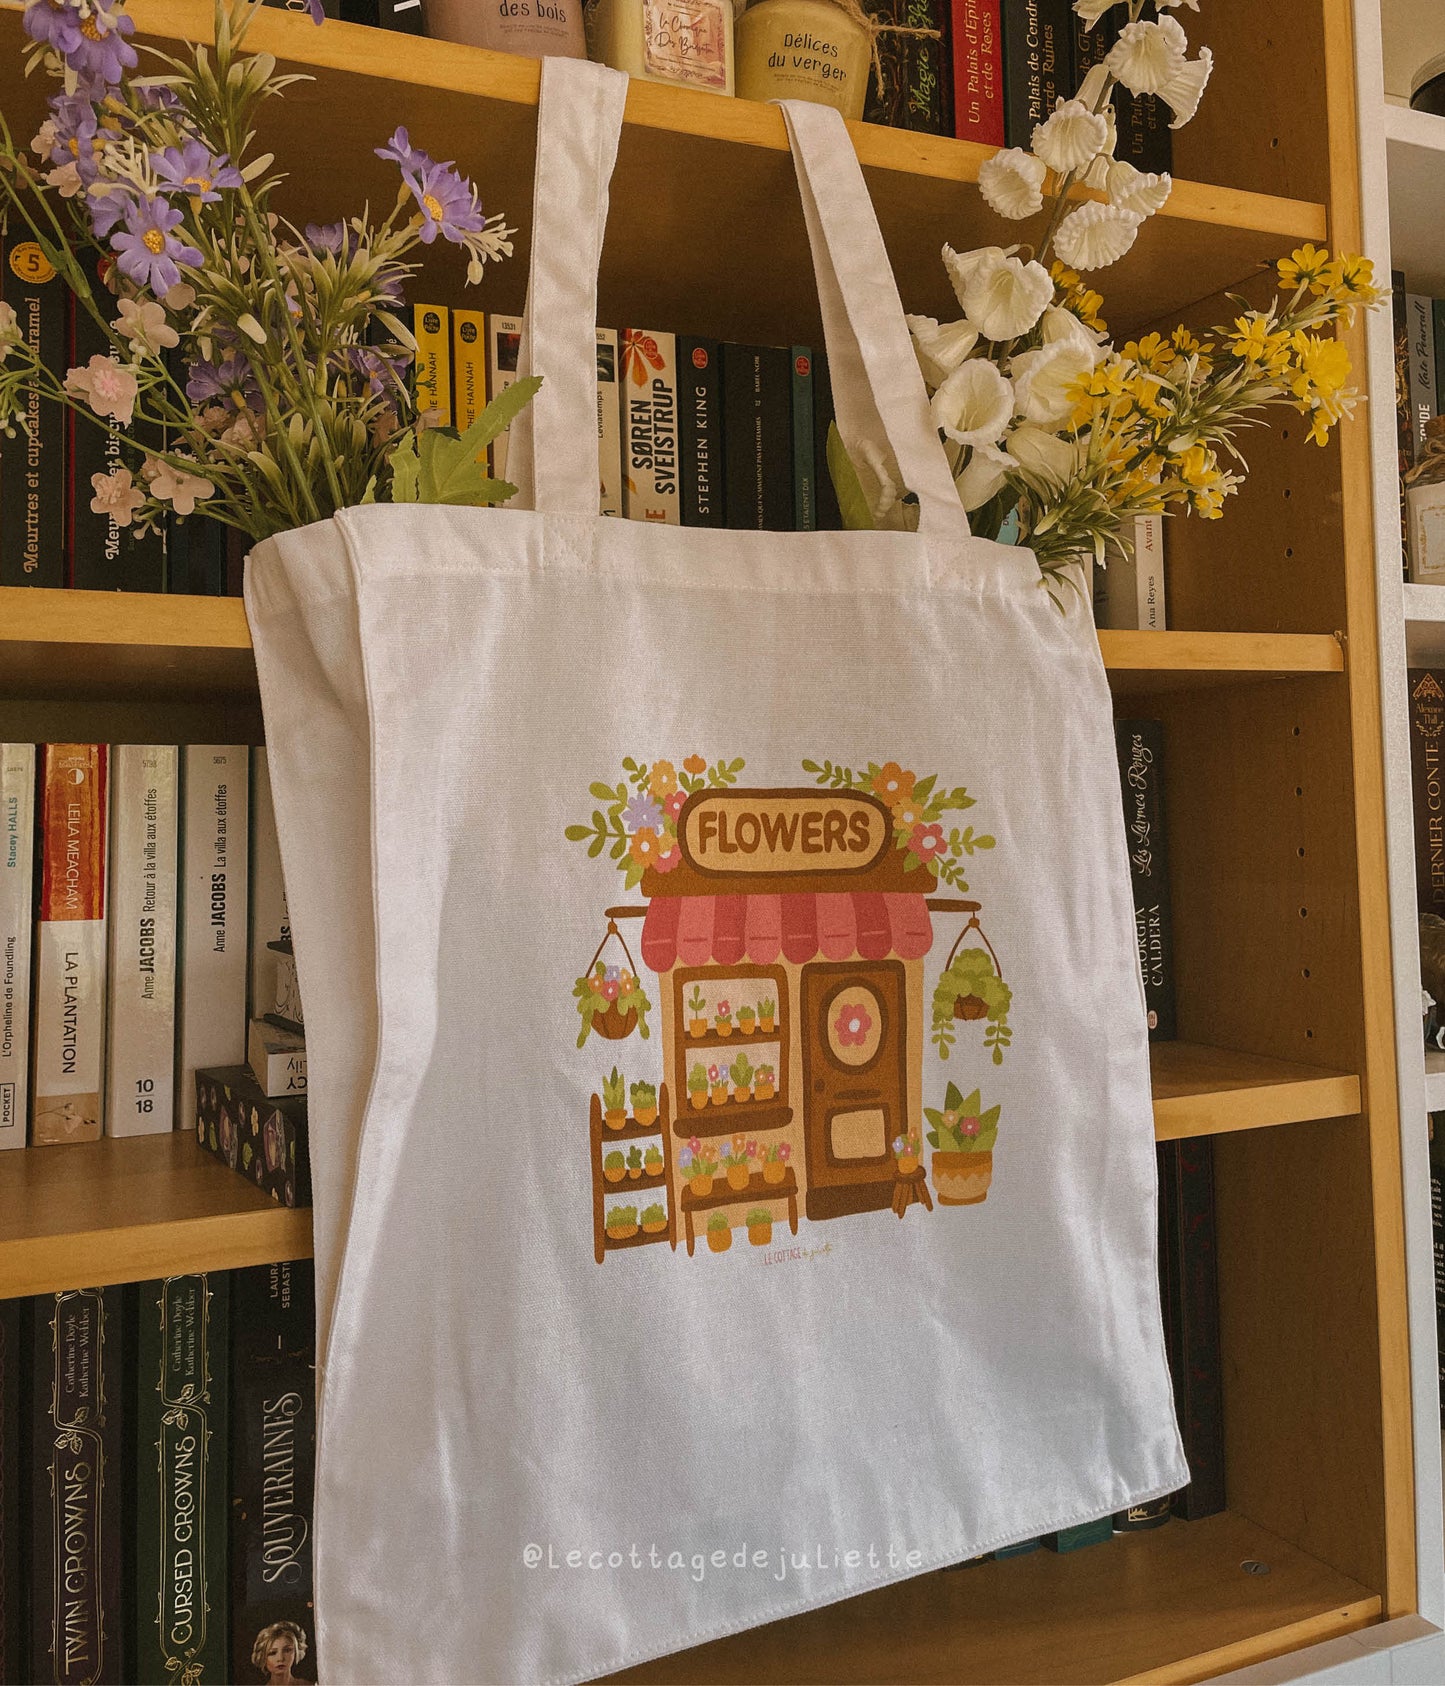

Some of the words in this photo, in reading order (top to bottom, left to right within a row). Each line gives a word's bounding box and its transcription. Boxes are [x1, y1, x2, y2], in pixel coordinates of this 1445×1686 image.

[500, 0, 530, 16] des
[537, 0, 566, 22] bois
[784, 33, 838, 58] Délices
[981, 11, 994, 56] Roses
[1043, 24, 1055, 75] Ruines
[768, 52, 786, 68] du
[793, 56, 847, 81] verger
[966, 48, 979, 95] Palais
[981, 62, 993, 80] de
[1026, 52, 1040, 71] de
[983, 82, 994, 99] et
[1028, 74, 1041, 119] Palais
[968, 100, 980, 123] Un
[28, 254, 40, 272] 5
[25, 297, 41, 360] aramel
[428, 352, 438, 396] HANNAH
[465, 361, 475, 406] HANNAH
[695, 386, 708, 429] KING
[26, 392, 43, 467] cupcakes
[630, 399, 653, 470] SØREN
[652, 378, 676, 495] SVEISTRUP
[25, 472, 39, 488] et
[697, 438, 710, 514] STEPHEN
[23, 492, 39, 573] Meurtres
[1145, 520, 1153, 552] Avant
[1147, 576, 1157, 605] Reyes
[1148, 607, 1156, 628] Ana
[1127, 734, 1153, 790] Rouges
[1425, 741, 1442, 812] CONTE
[8, 797, 18, 833] HALLS
[144, 788, 157, 821] étoffes
[214, 784, 227, 816] étoffes
[67, 803, 81, 838] LEILA
[147, 823, 156, 840] aux
[217, 818, 227, 835] aux
[698, 809, 870, 854] FLOWERS
[1131, 793, 1151, 847] Larmes
[7, 834, 19, 868] Stacey
[144, 842, 156, 860] villa
[214, 836, 226, 855] villa
[214, 856, 226, 867] La
[1132, 849, 1152, 877] Les
[66, 840, 81, 910] MEACHAM
[144, 862, 156, 871] la
[143, 882, 156, 912] Retour
[211, 873, 226, 927] JACOBS
[139, 918, 155, 973] JACOBS
[213, 929, 225, 952] Anne
[1149, 904, 1164, 987] CALDERA
[4, 936, 17, 985] Foundling
[65, 951, 79, 972] LA
[6, 988, 14, 1000] de
[141, 976, 155, 999] Anne
[2, 1003, 14, 1058] L'Orpheline
[62, 976, 79, 1074] PLANTATION
[136, 1079, 154, 1093] 10
[3, 1088, 12, 1123] POCKET
[136, 1099, 153, 1114] 18
[65, 1314, 79, 1342] Doyle
[79, 1307, 90, 1348] Webber
[174, 1435, 196, 1543] CROWNS
[262, 1392, 308, 1585] SOUVERAINES
[65, 1462, 92, 1593] CROWNS
[171, 1549, 193, 1645] CURSED
[65, 1601, 89, 1675] TWIN
